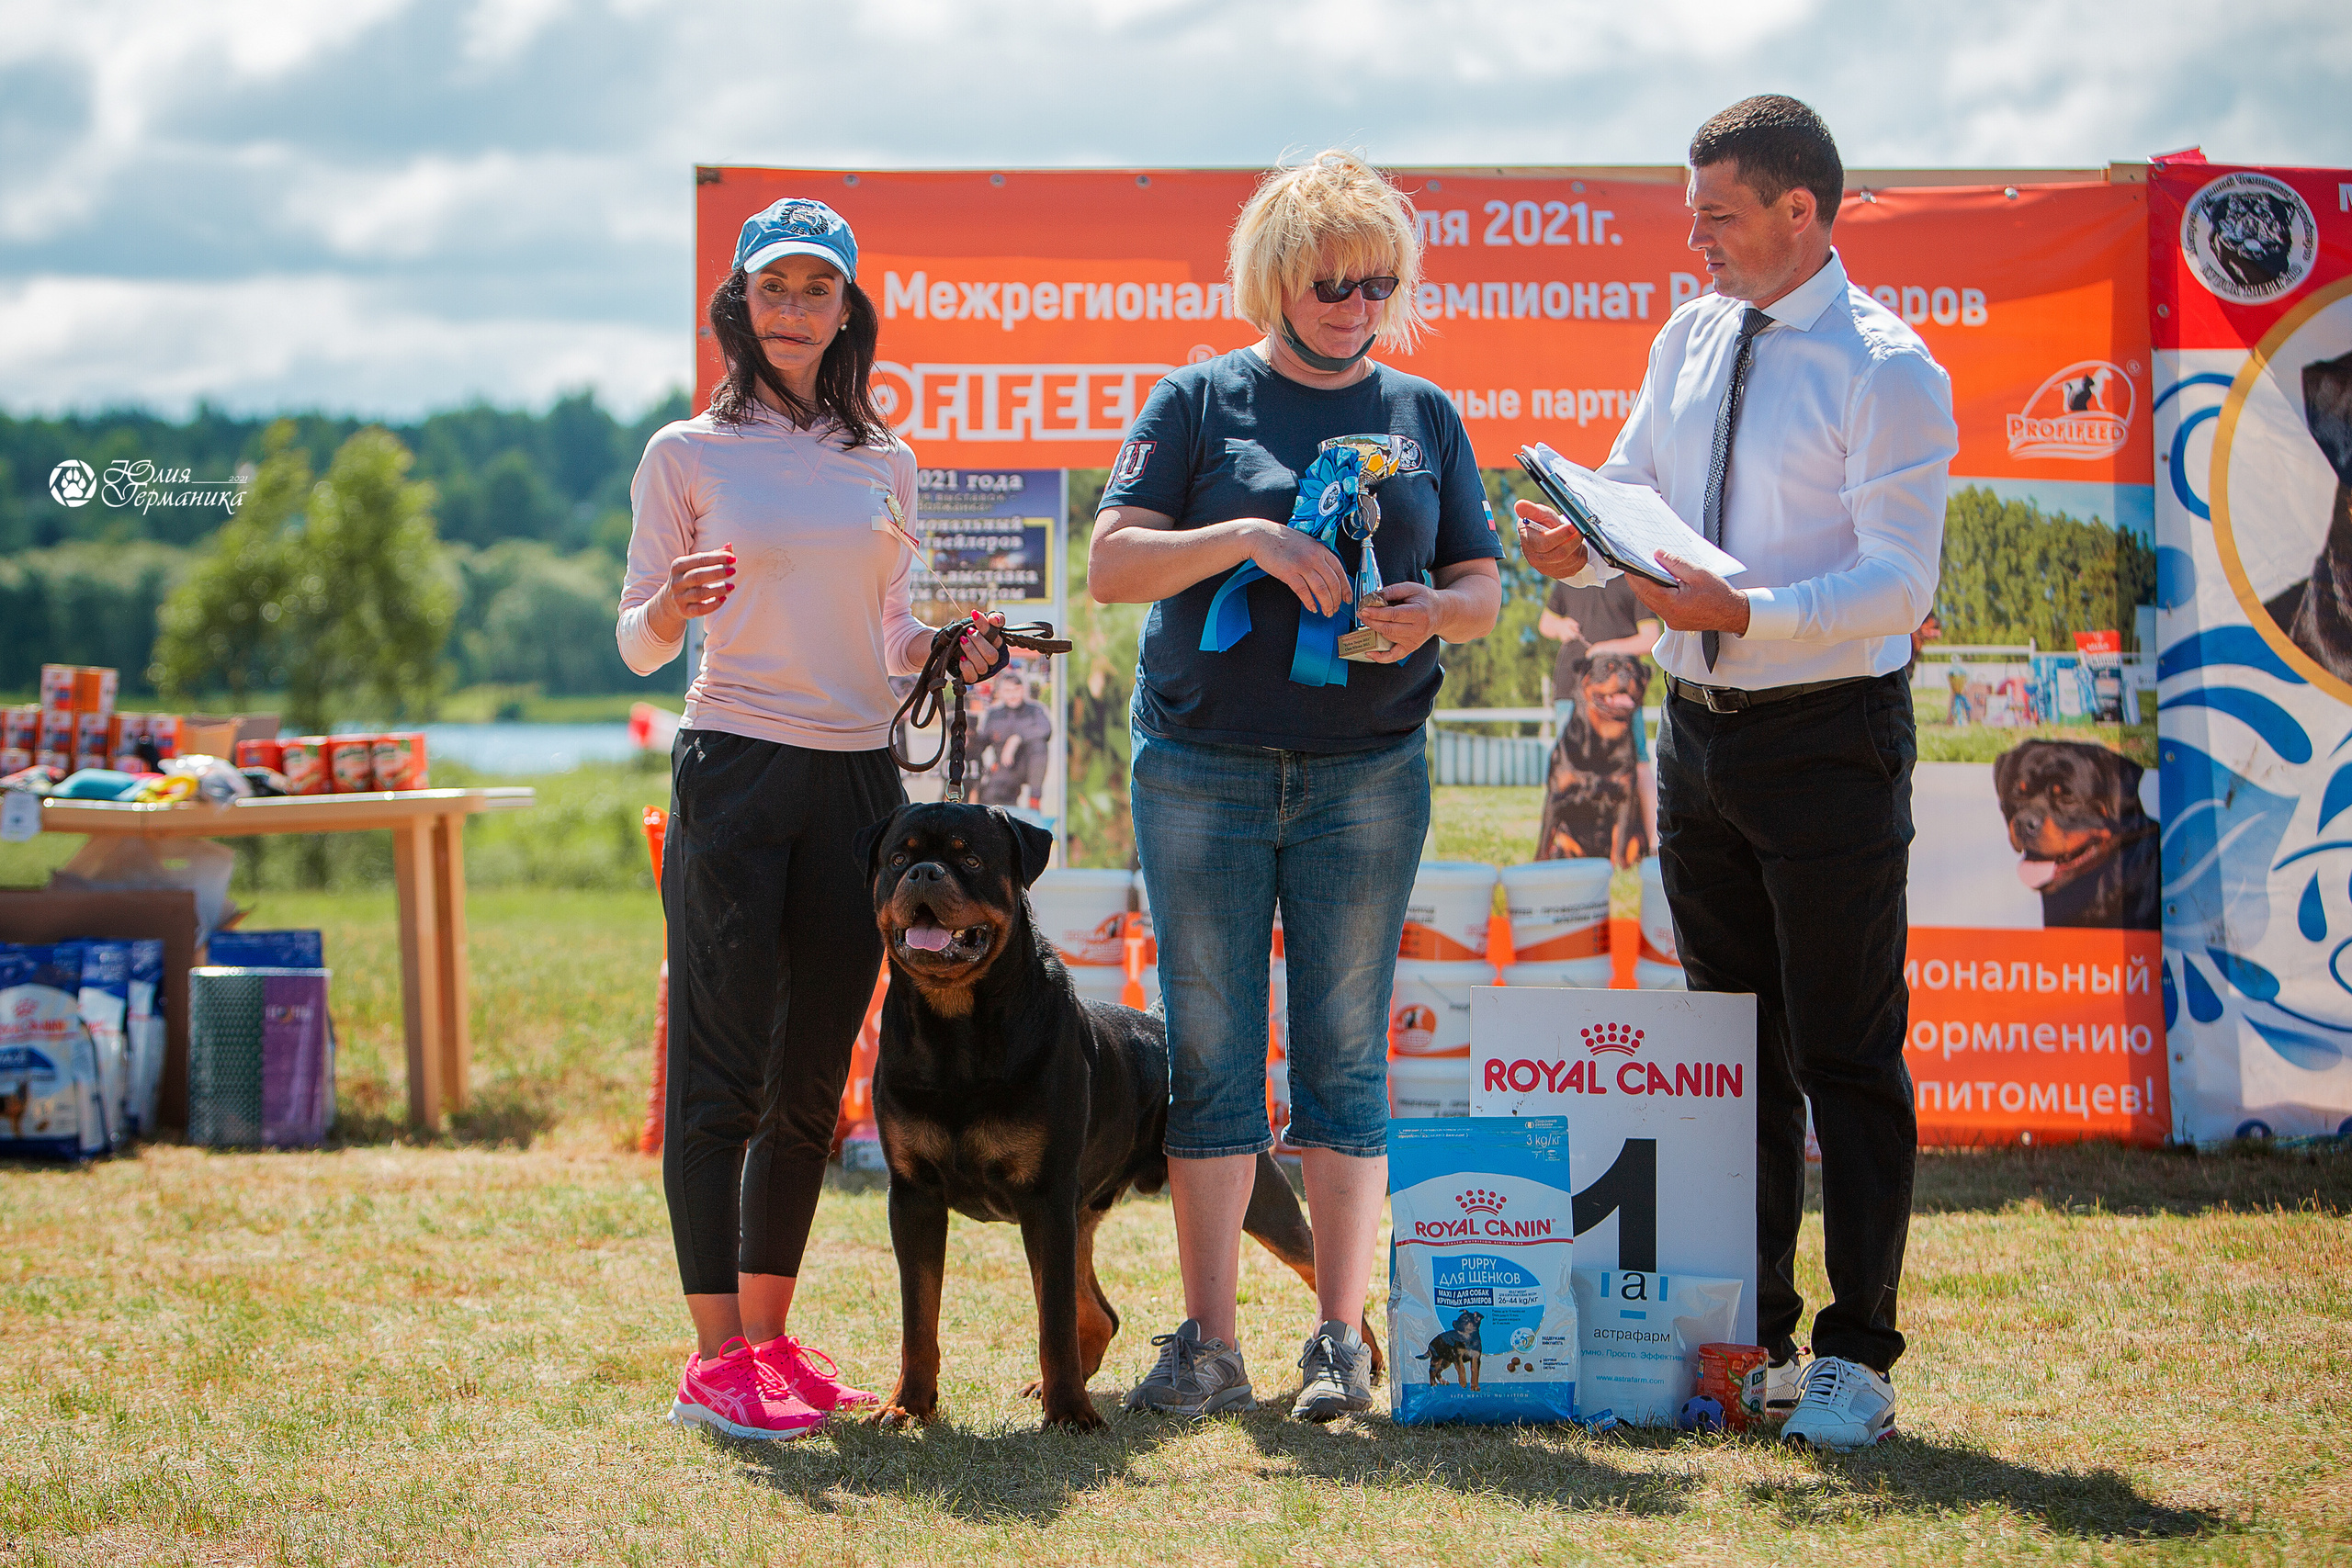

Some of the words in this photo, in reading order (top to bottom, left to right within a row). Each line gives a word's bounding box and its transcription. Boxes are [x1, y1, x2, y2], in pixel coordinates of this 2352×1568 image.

[1420, 209, 1470, 246] ля
[1483, 199, 1623, 246] 2021г.
[884, 270, 1235, 331] Межрегионал
[1416, 281, 1656, 320] емпионат
[867, 361, 1182, 442] OFIFEE
[1444, 388, 1521, 419] ные
[1532, 388, 1637, 428] партн
[2007, 413, 2128, 444] PROFIFEED
[918, 468, 959, 491] 021
[967, 474, 1024, 492] года
[918, 516, 1024, 532] иональный
[921, 534, 1024, 554] твейлеров
[935, 587, 1026, 606] статусом
[1905, 954, 2150, 995] иональный
[1905, 1020, 2153, 1061] ормлению
[1484, 1058, 1607, 1095] ROYAL
[1616, 1061, 1743, 1098] CANIN
[1917, 1076, 2154, 1122] питомцев!
[1526, 1134, 1532, 1145] 3
[1571, 1137, 1657, 1275] 1
[1415, 1218, 1480, 1237] ROYAL
[1485, 1218, 1551, 1237] CANIN
[1462, 1258, 1497, 1270] PUPPY
[1440, 1272, 1464, 1287] ДЛЯ
[1469, 1271, 1521, 1284] ЩЕНКОВ
[1437, 1297, 1463, 1305] КРУПНЫХ
[1593, 1328, 1670, 1344] астрафарм
[1596, 1375, 1664, 1384] www.astrafarm.com
